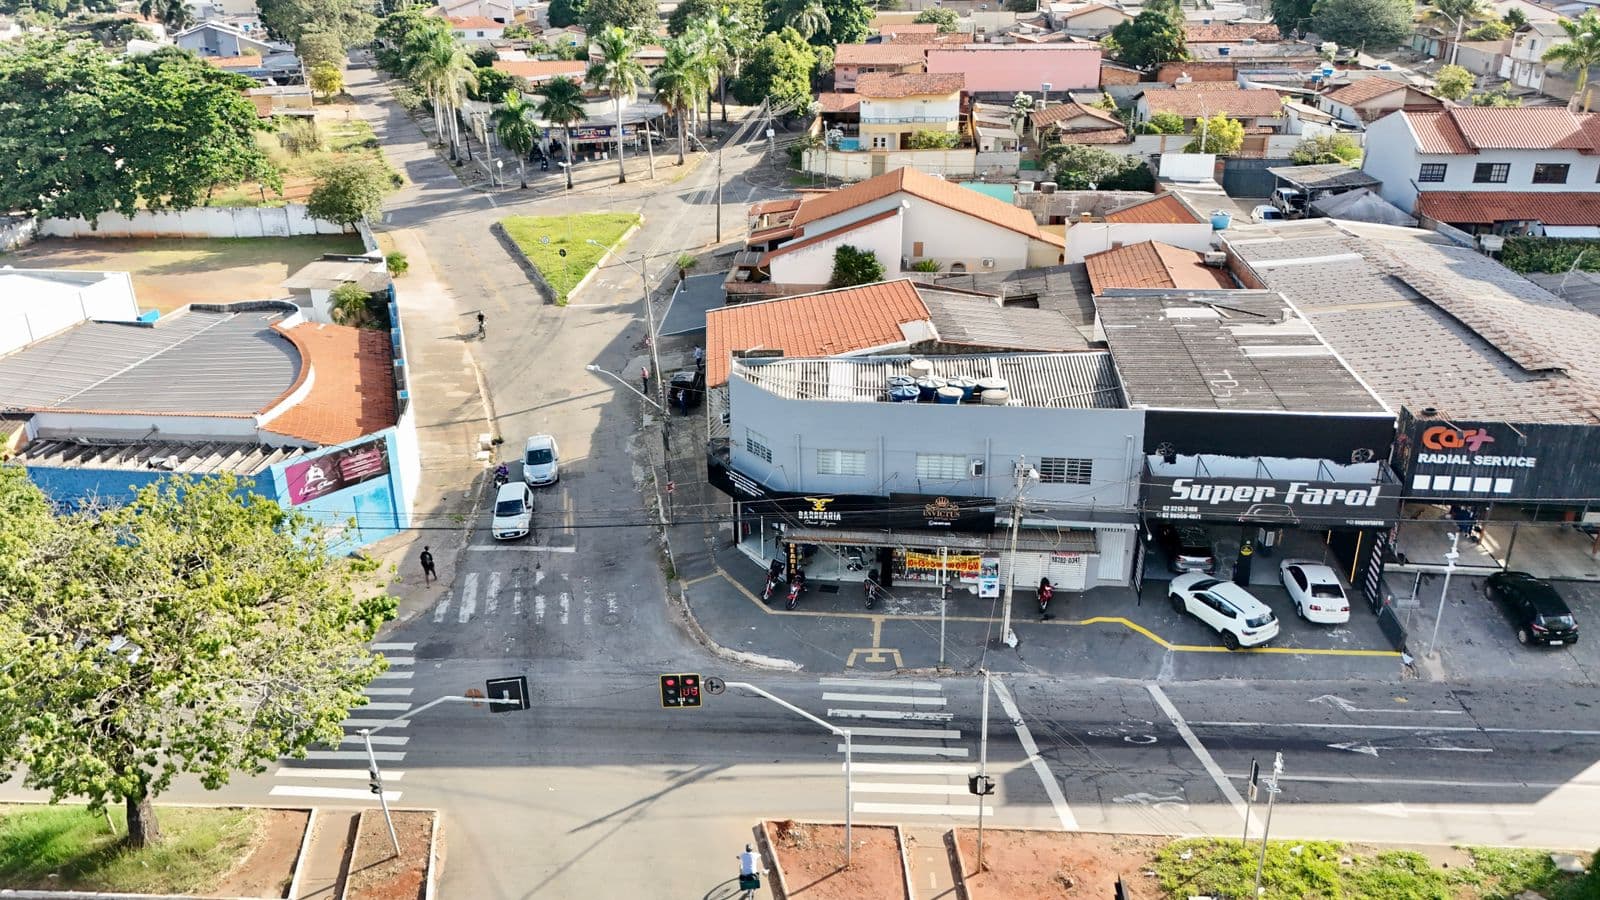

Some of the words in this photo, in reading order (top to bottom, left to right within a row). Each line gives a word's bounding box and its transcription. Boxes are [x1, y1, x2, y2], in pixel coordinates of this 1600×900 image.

[1418, 453, 1470, 465] RADIAL
[1473, 456, 1537, 467] SERVICE
[1170, 478, 1276, 504] Super
[1285, 482, 1382, 507] Farol
